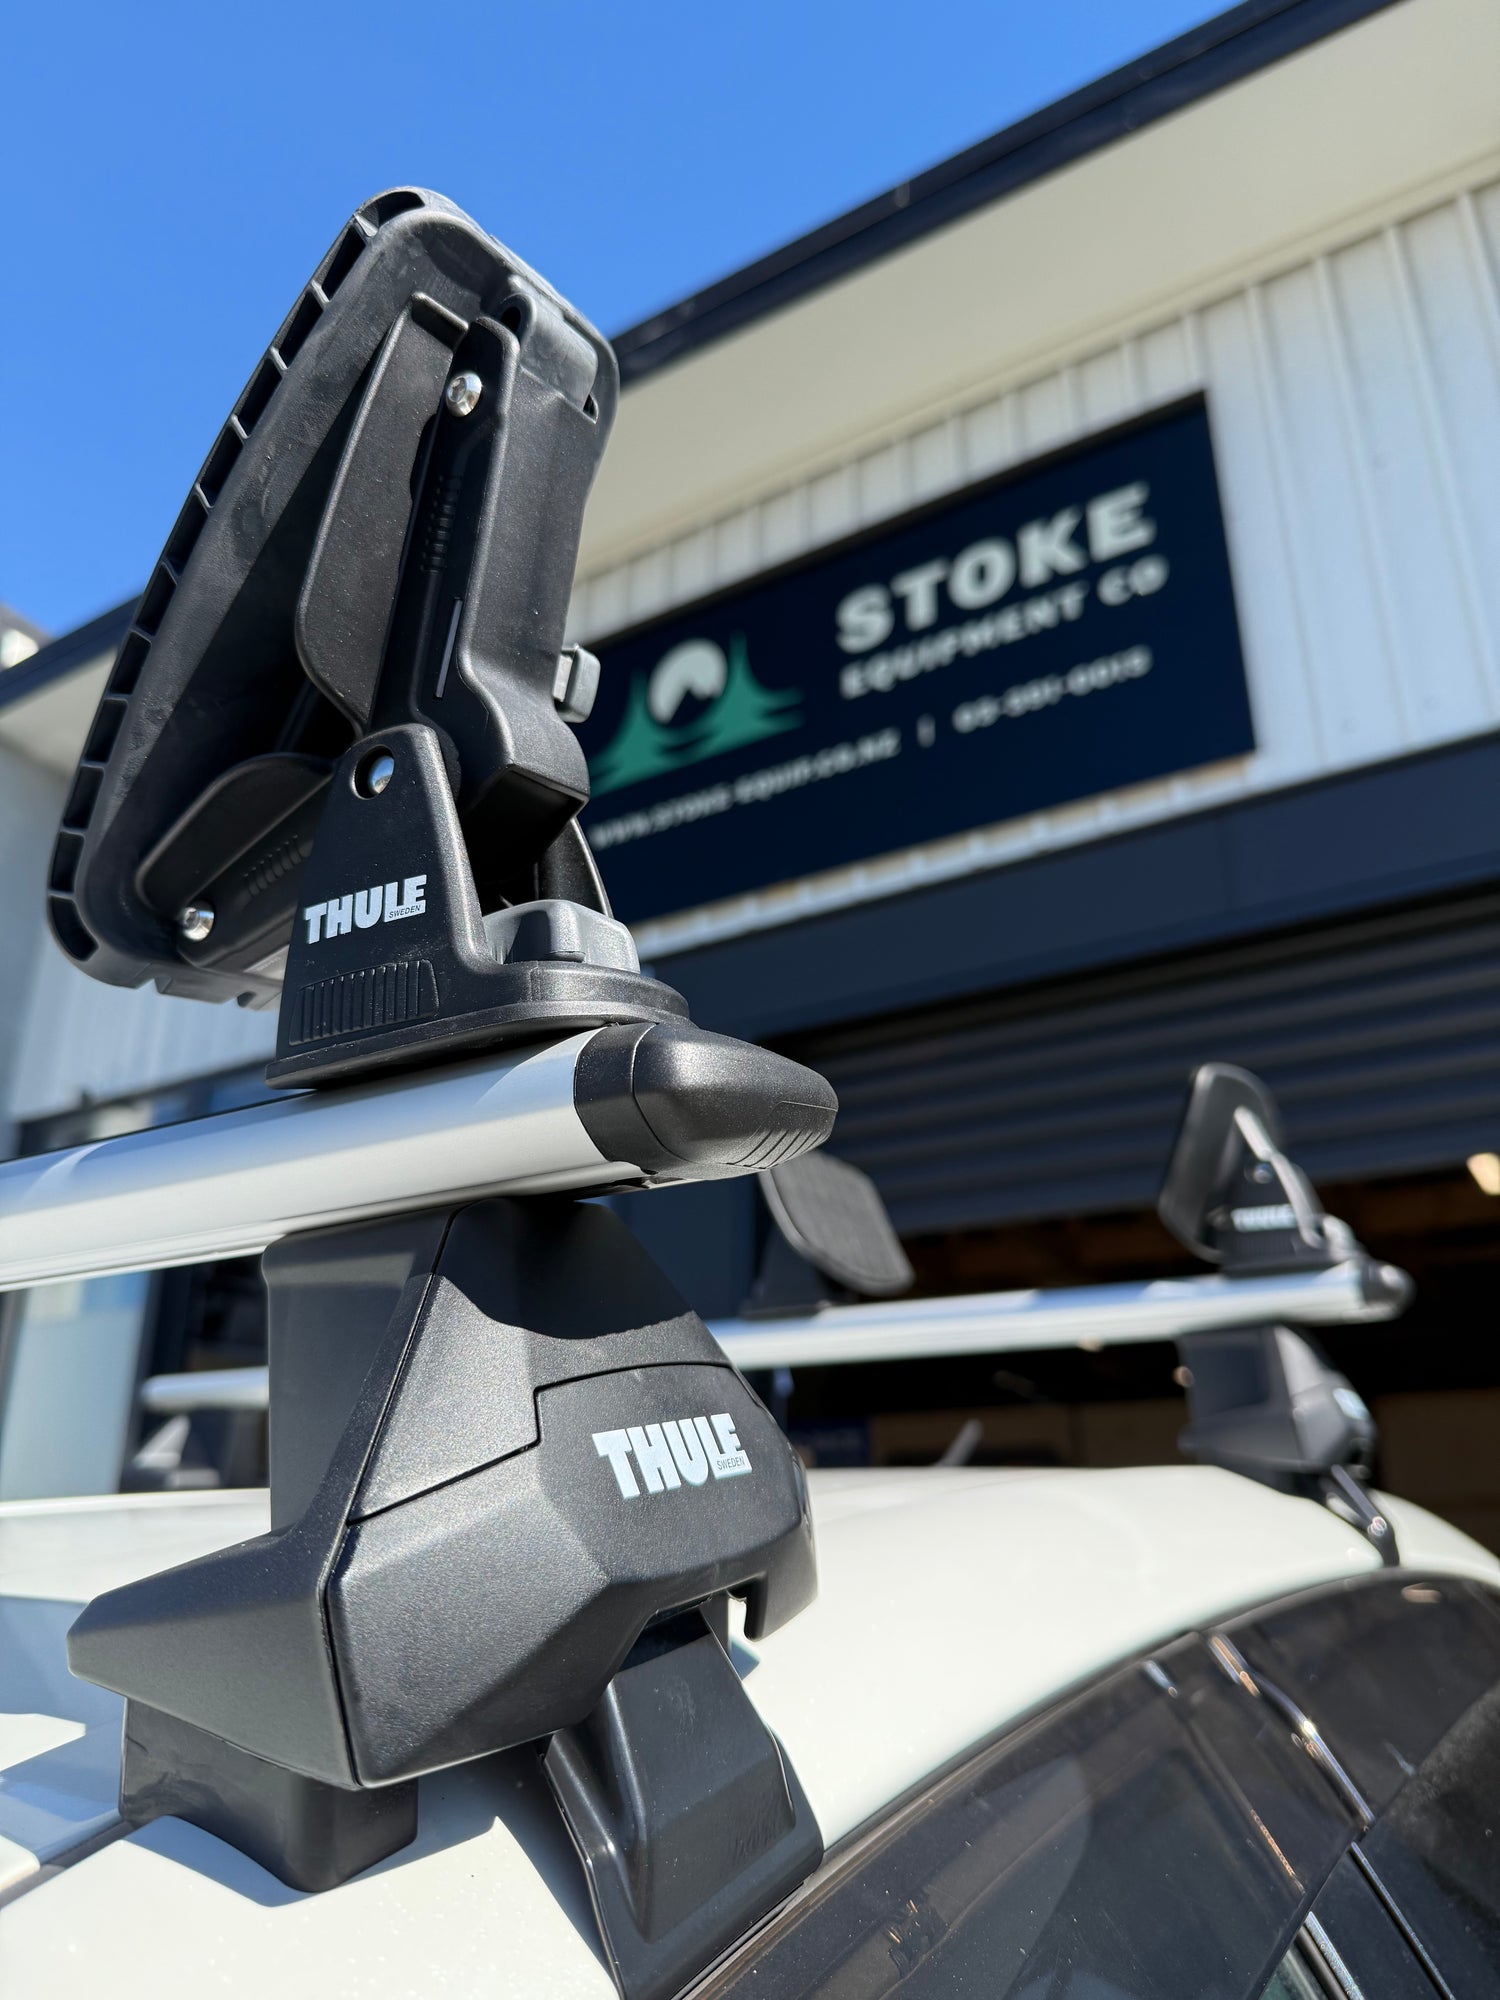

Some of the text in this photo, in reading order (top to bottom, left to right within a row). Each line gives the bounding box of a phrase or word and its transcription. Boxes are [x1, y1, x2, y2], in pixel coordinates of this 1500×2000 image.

[837, 481, 1157, 653] STOKE
[841, 555, 1168, 698] EQUIPMENT CO
[304, 875, 427, 944] THULE
[389, 904, 421, 919] SWEDEN
[592, 1413, 752, 1499] THULE
[716, 1456, 745, 1471] SWEDEN
